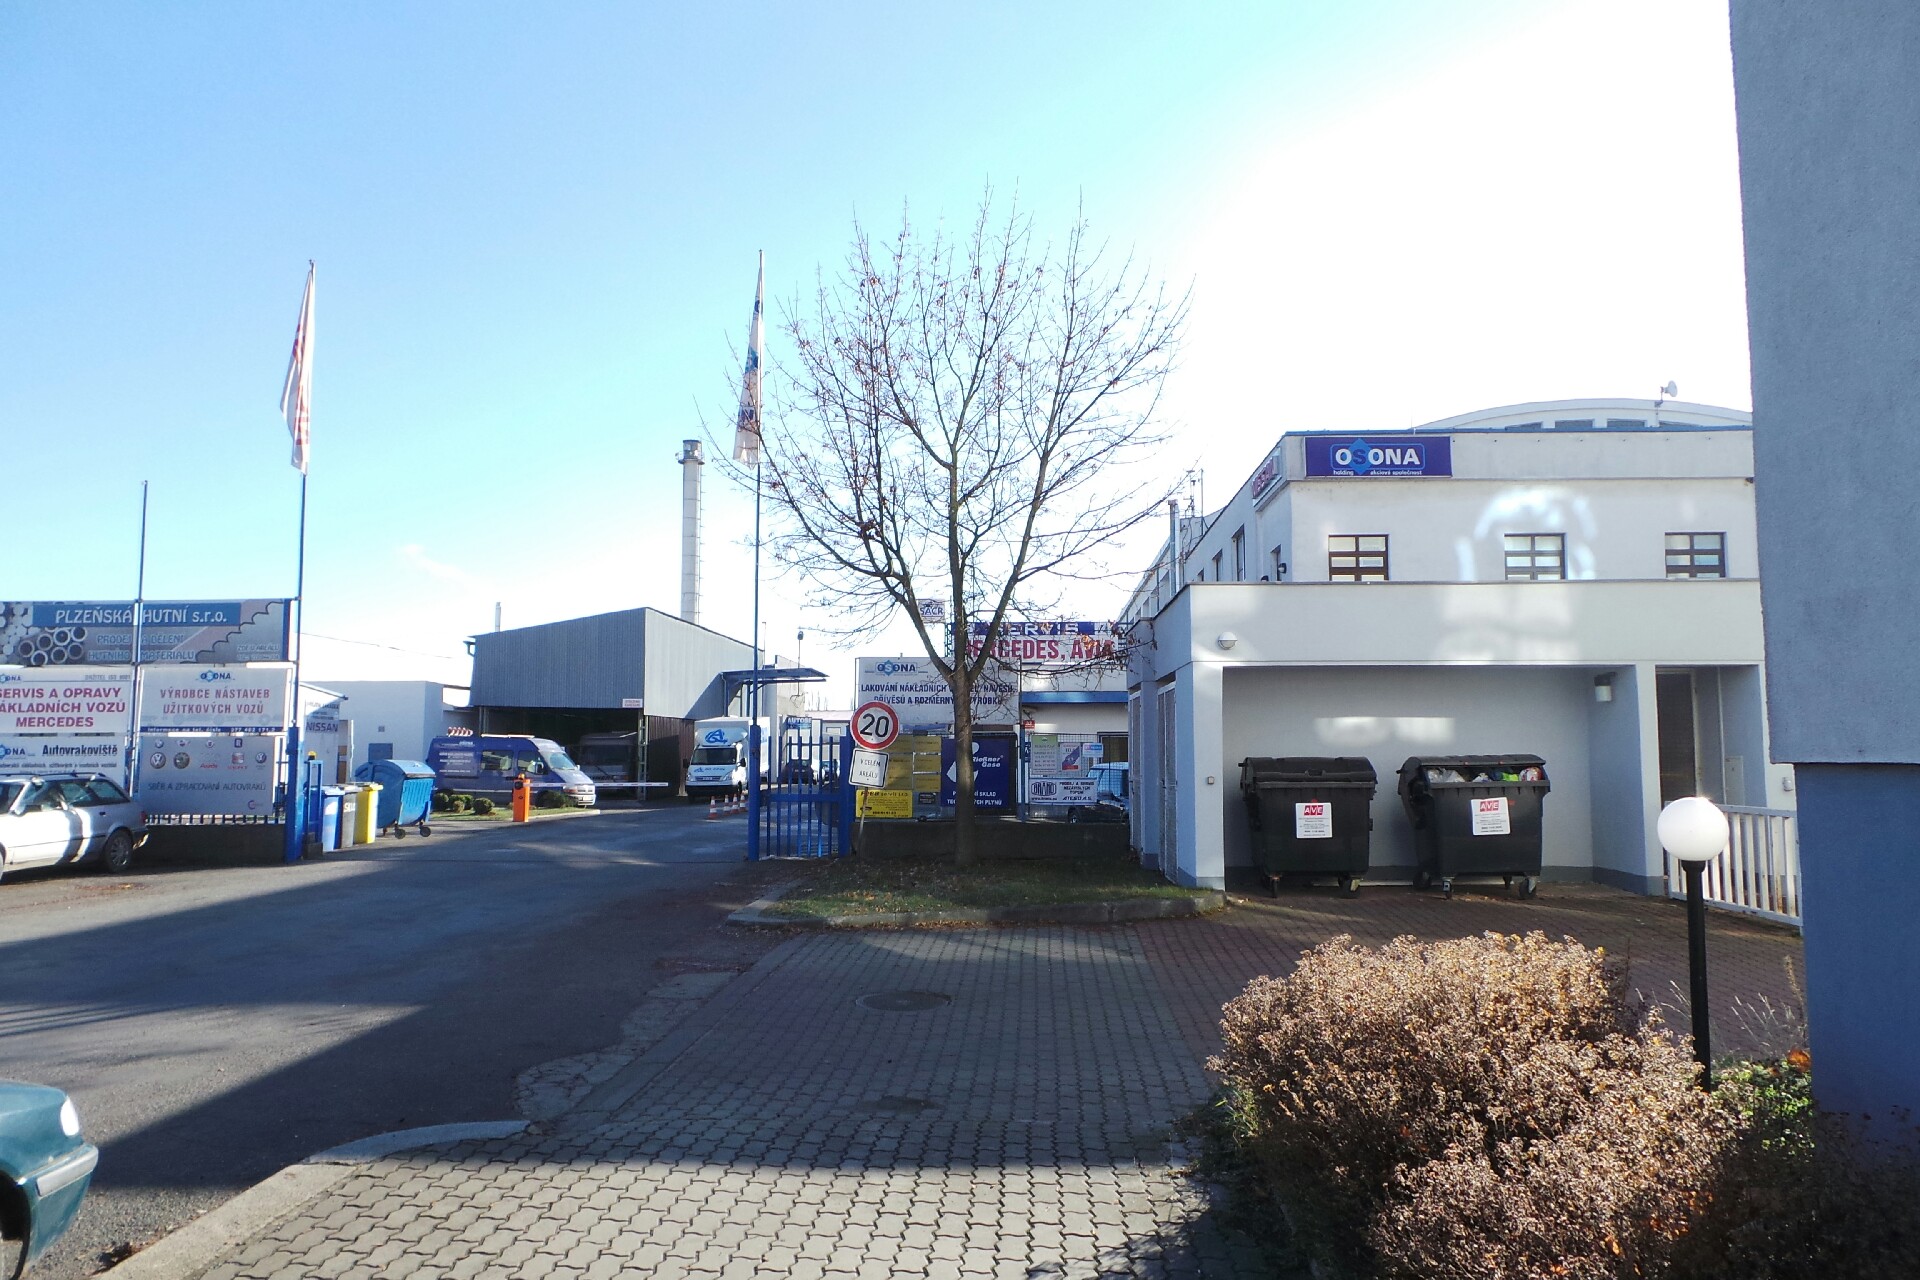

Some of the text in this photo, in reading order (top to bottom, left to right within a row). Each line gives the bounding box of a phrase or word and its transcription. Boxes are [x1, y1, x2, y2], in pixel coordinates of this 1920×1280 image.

[1335, 448, 1421, 466] OSONA
[55, 605, 227, 624] PLZEŇSKÁ HUTNÍ s.r.o.
[97, 634, 131, 645] PRODEJ
[88, 649, 131, 661] HUTNÍHO
[966, 640, 1066, 660] ECEDES,
[877, 663, 916, 672] OSONA
[200, 672, 231, 680] OSONA
[861, 682, 898, 692] LAKOVÁNÍ
[899, 682, 947, 692] NÁKLADNÍCH
[0, 688, 121, 699] ERVIS A OPRAVY
[160, 687, 270, 699] VÝROBCE NÁSTAVEB
[907, 696, 912, 704] A
[0, 699, 125, 713] ÁKLADNÍCH VOZŮ
[163, 701, 264, 714] UŽITKOVÝCH VOZŮ
[16, 717, 94, 728] MERCEDES
[306, 722, 338, 732] NISSAN
[860, 713, 889, 737] 20
[42, 744, 118, 756] Autovrakoviště
[1304, 805, 1323, 816] AVE
[1479, 801, 1499, 812] AVE
